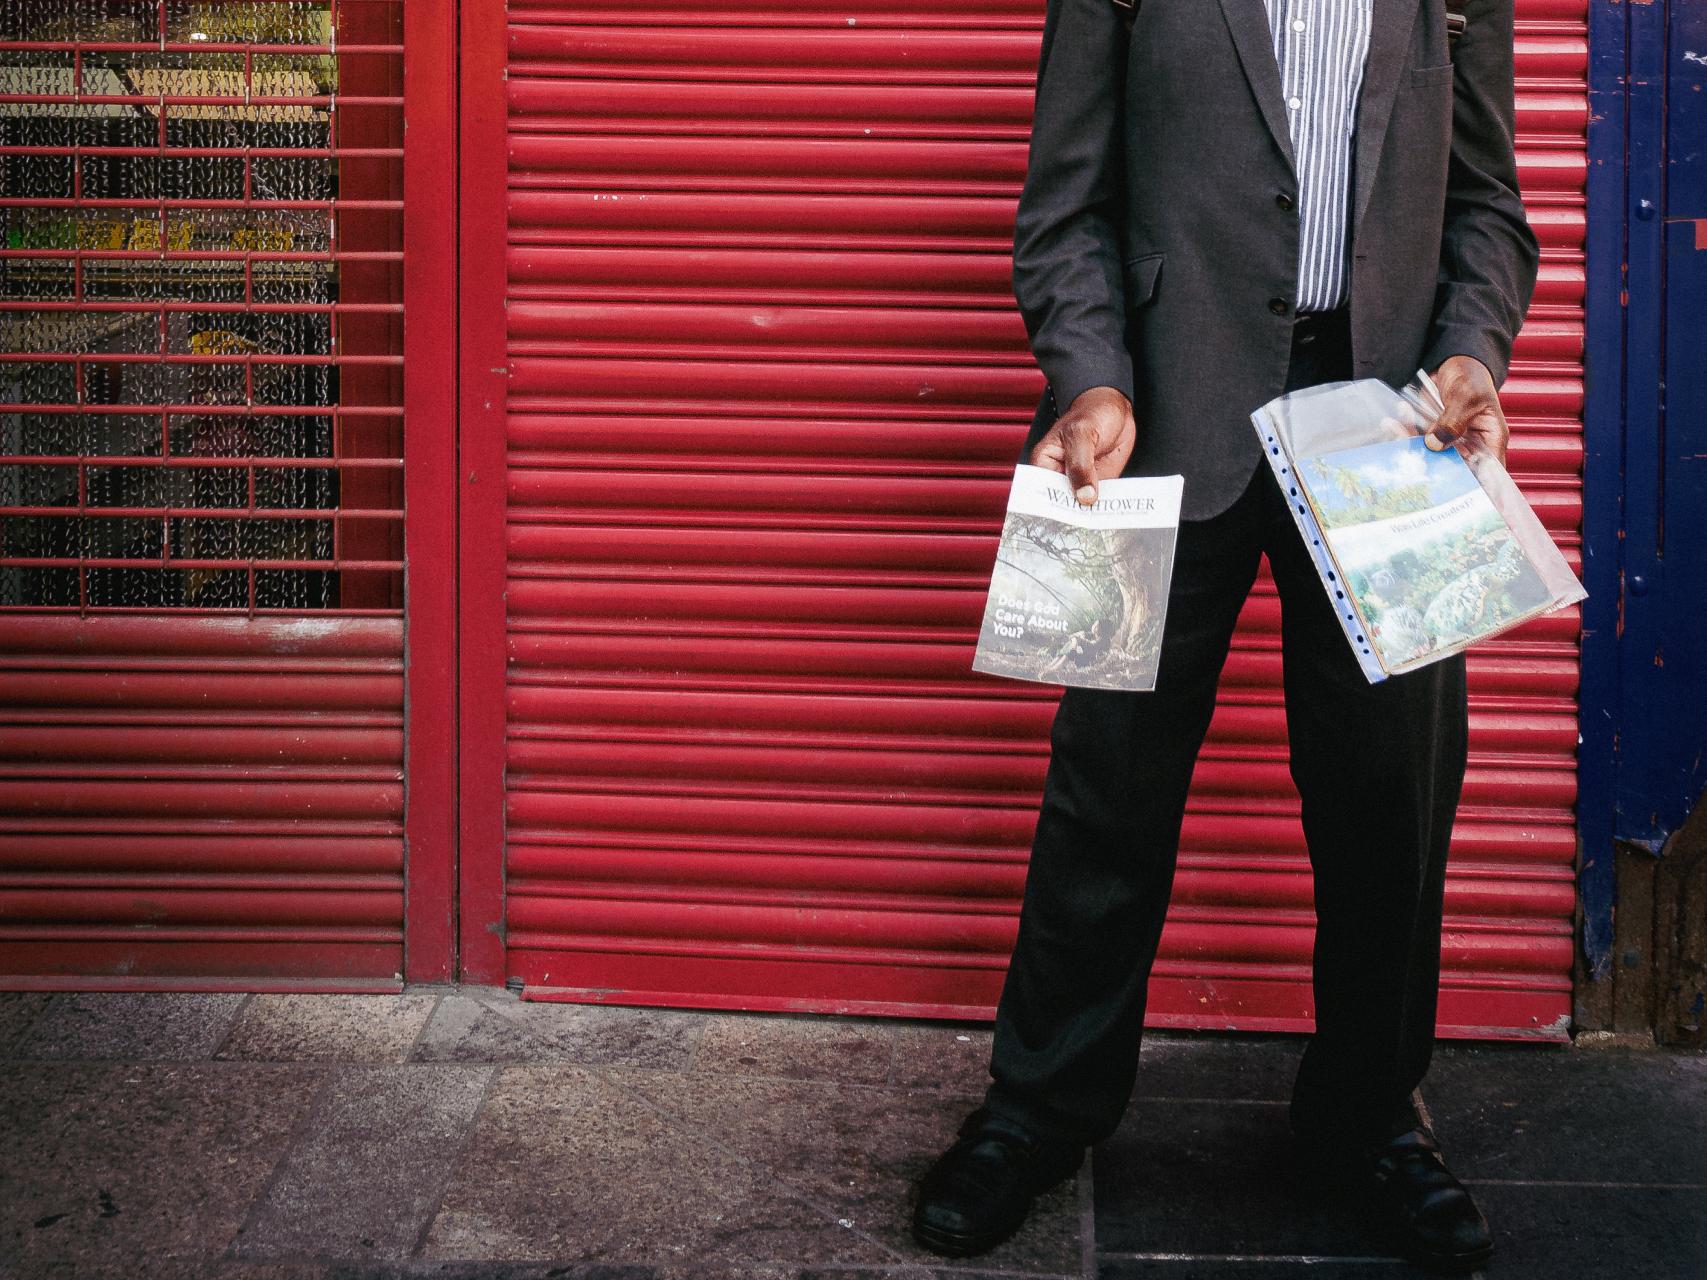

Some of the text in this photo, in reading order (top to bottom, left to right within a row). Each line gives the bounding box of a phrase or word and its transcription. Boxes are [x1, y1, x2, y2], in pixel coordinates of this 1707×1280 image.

[998, 595, 1060, 616] Does God
[993, 621, 1024, 639] You?
[995, 608, 1069, 631] Care About
